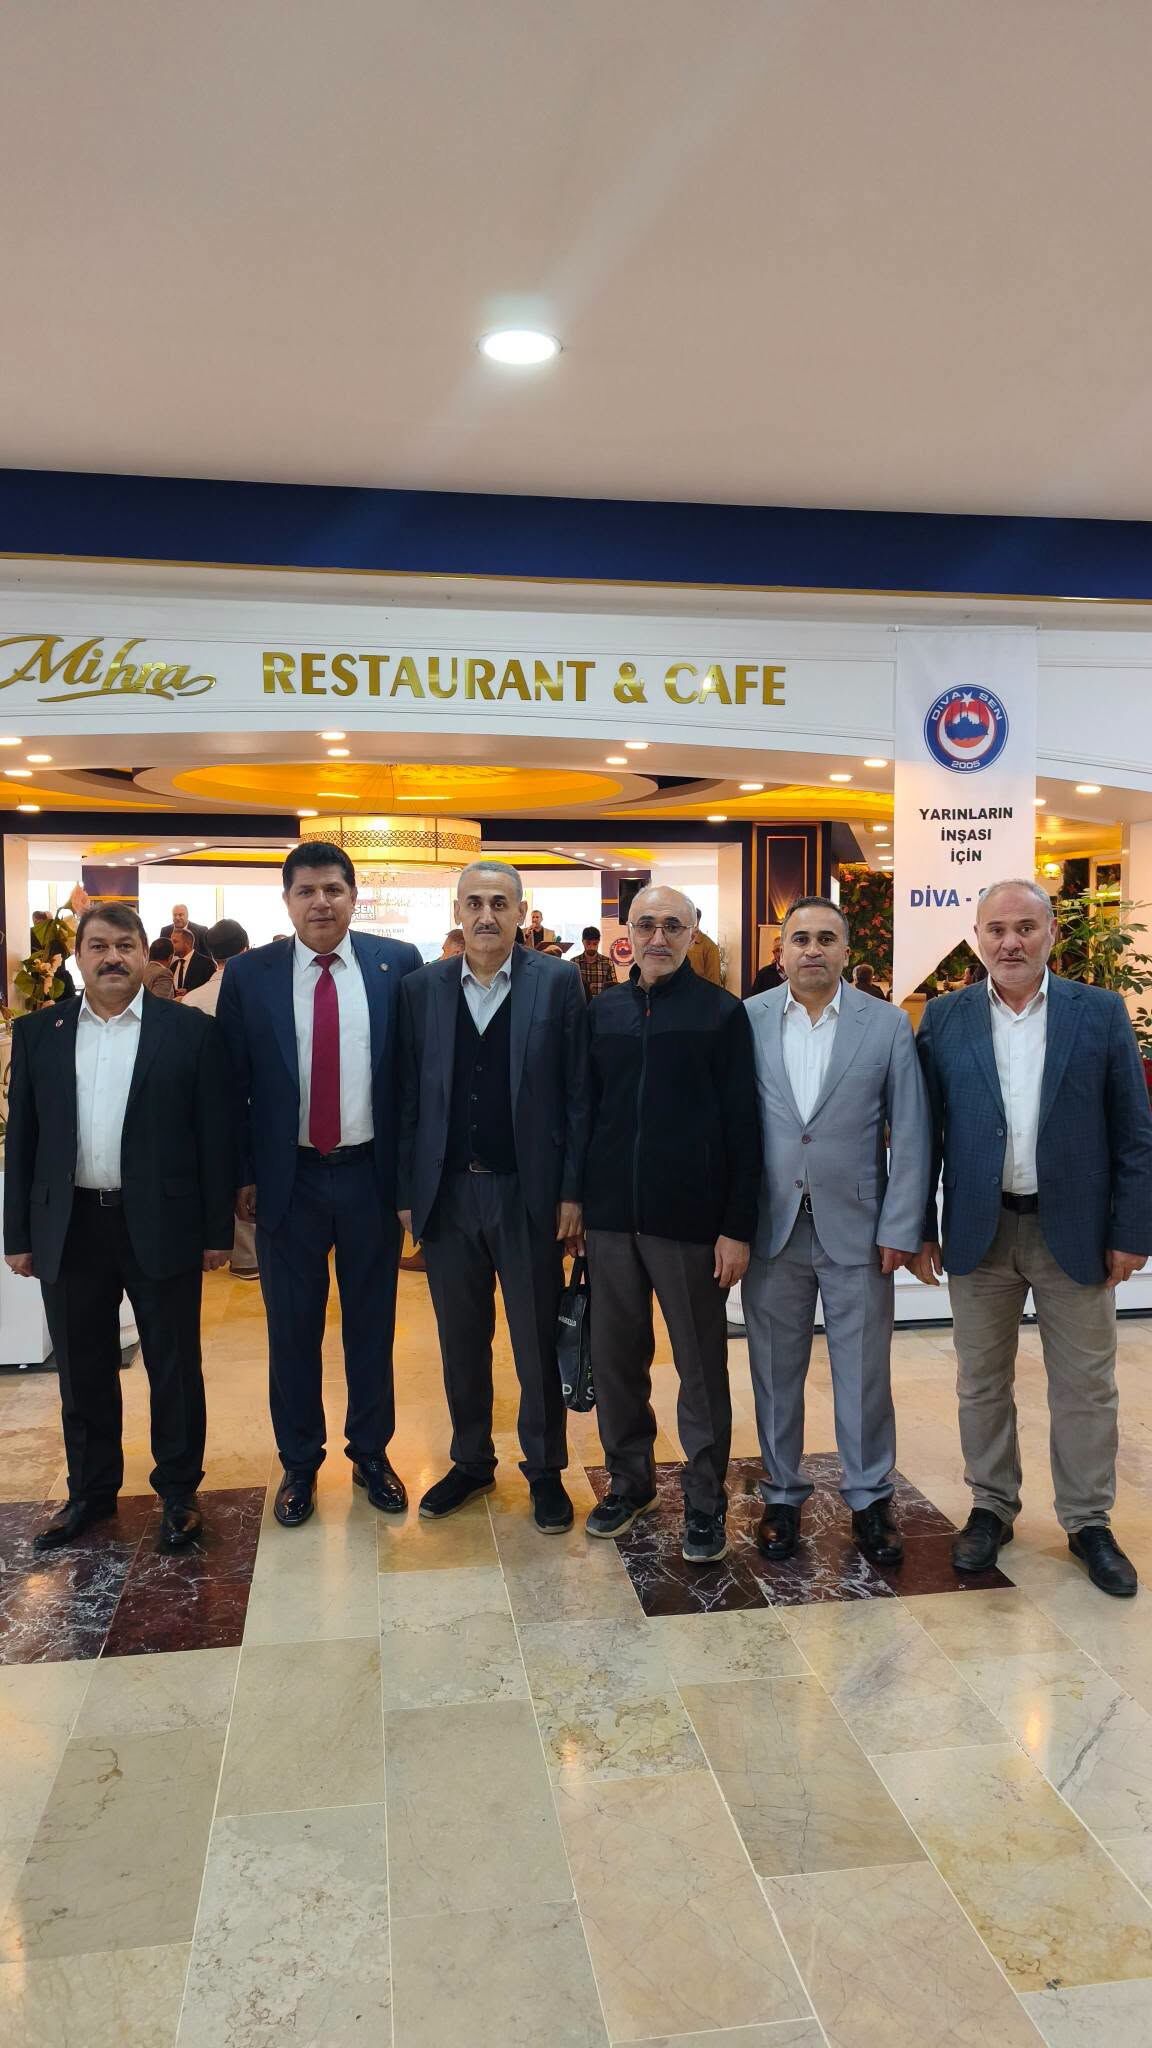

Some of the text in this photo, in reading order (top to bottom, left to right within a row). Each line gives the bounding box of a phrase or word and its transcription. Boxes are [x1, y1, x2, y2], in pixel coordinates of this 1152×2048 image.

[0, 634, 786, 705] Mihra RESTAURANT & CAFE
[951, 760, 981, 769] 2005
[919, 807, 1013, 820] YARINLARIN
[941, 827, 991, 844] İNŞASI
[951, 848, 982, 865] İÇİN
[910, 884, 960, 907] DİVA
